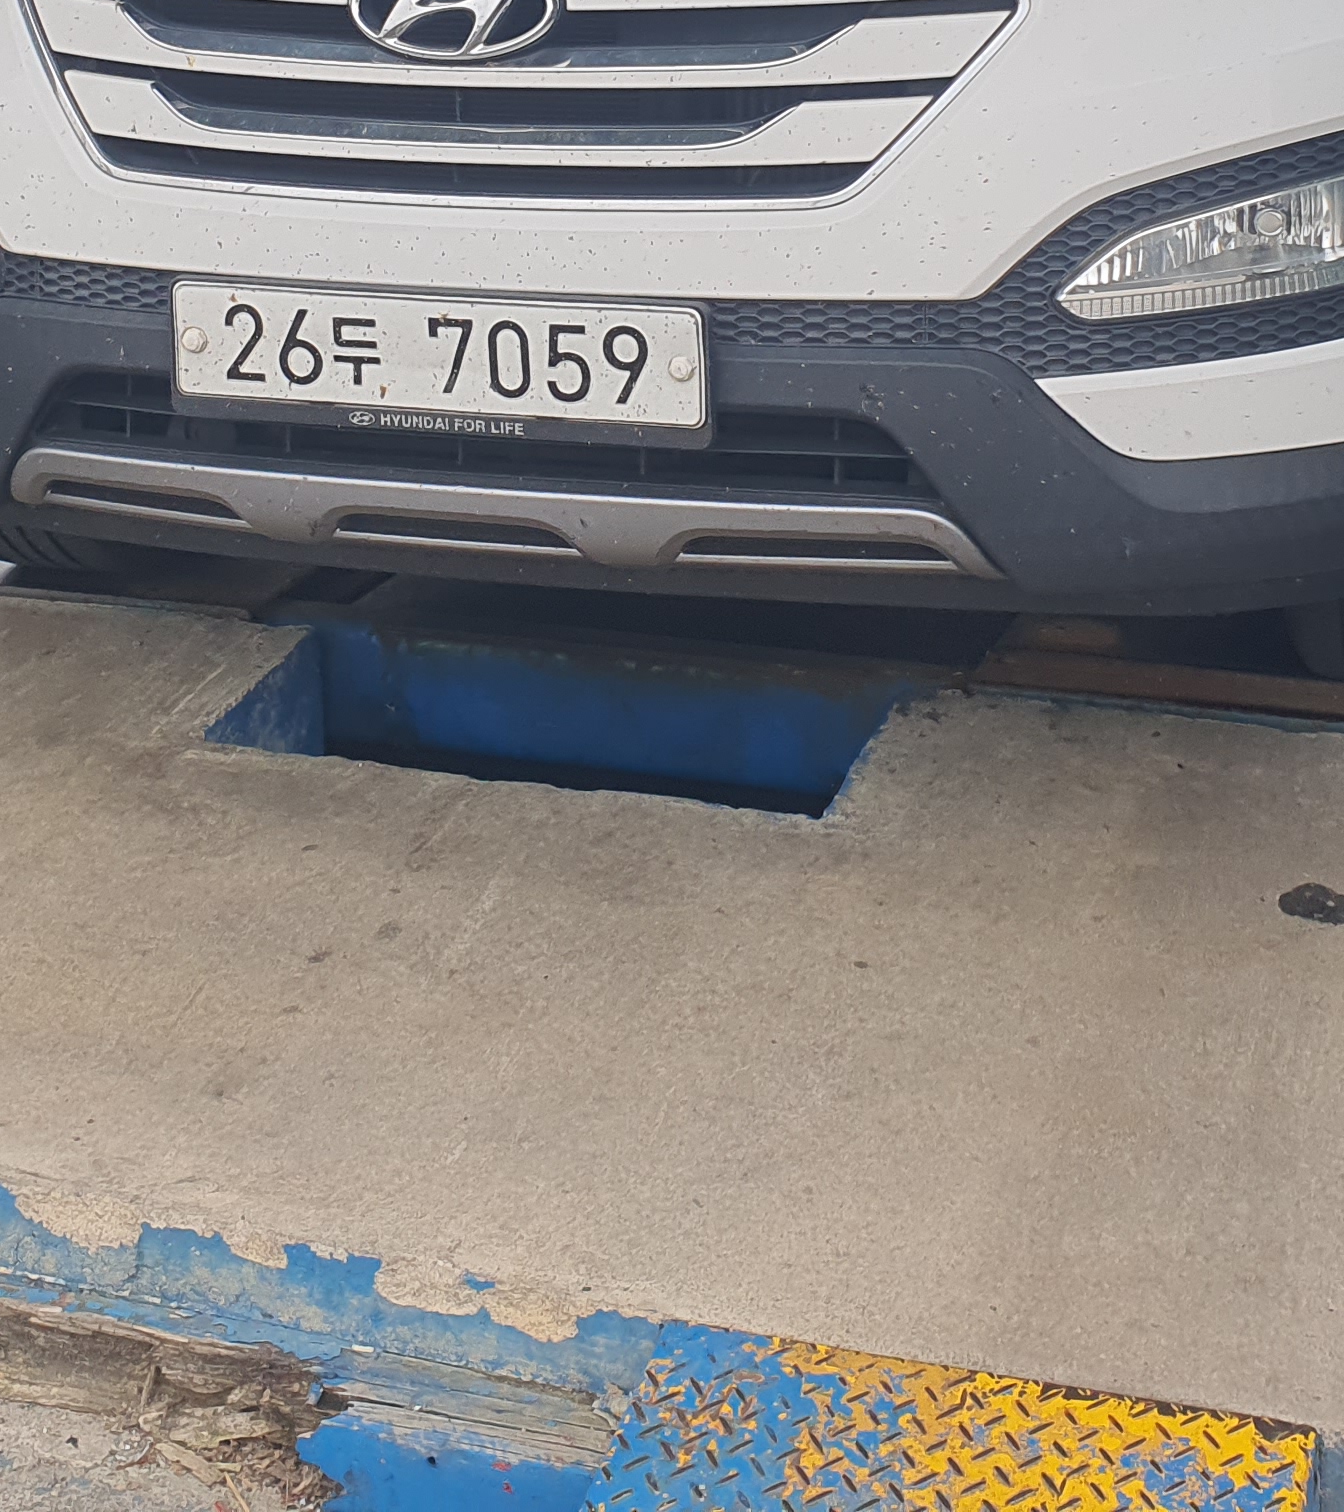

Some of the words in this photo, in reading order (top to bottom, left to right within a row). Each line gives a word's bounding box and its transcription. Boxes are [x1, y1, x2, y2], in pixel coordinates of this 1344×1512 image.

[224, 302, 382, 386] 26두
[427, 317, 649, 405] 7059
[380, 413, 450, 431] HYUNDAI
[454, 418, 486, 433] FOR
[490, 421, 525, 436] LIFE
